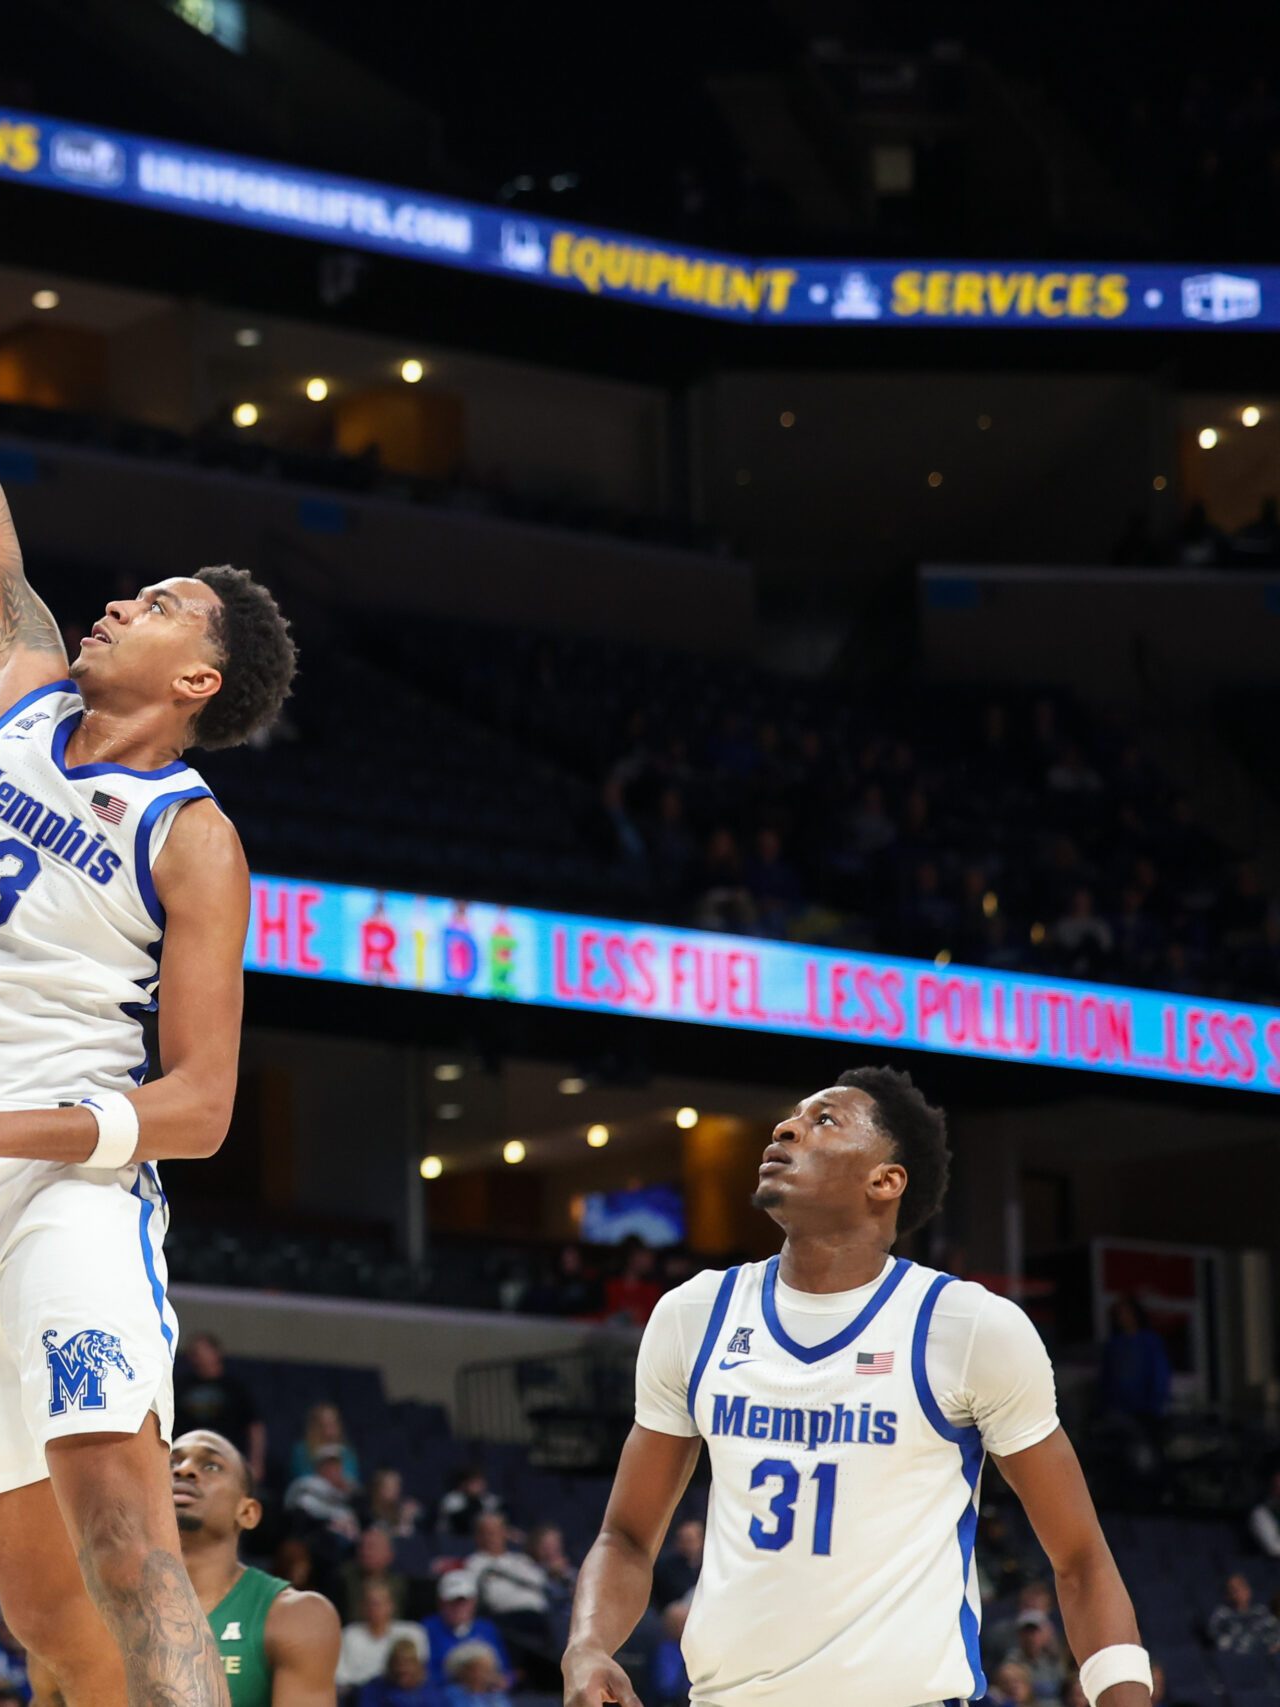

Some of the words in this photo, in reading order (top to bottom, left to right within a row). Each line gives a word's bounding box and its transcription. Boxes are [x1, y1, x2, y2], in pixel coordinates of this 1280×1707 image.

[548, 232, 797, 313] EQUIPMENT
[891, 270, 1128, 318] SERVICES
[360, 917, 518, 998] RIDE
[553, 923, 658, 1008] LESS
[711, 1393, 897, 1451] Memphis
[749, 1458, 838, 1557] 31
